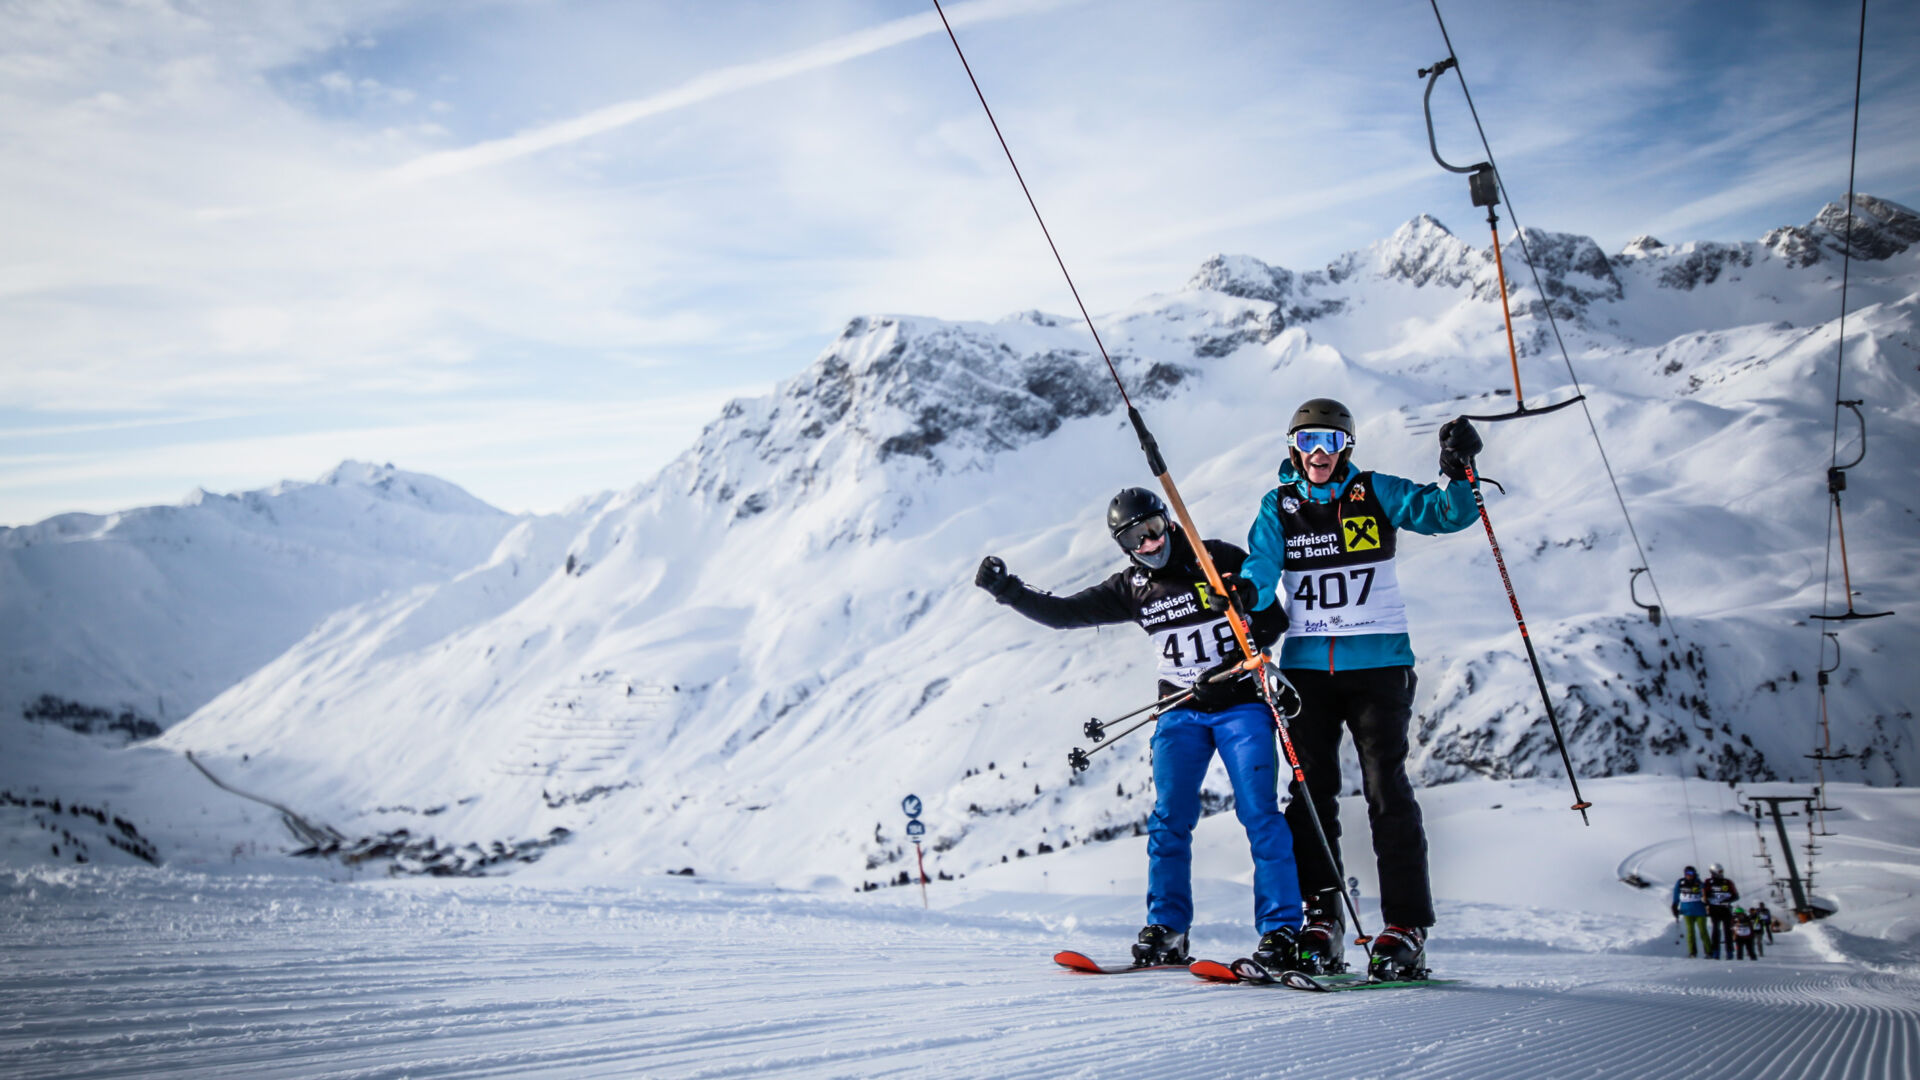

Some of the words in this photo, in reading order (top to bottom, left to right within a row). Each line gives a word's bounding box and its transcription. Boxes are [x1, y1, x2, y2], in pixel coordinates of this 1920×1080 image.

[1286, 533, 1337, 547] aiffeisen
[1305, 543, 1340, 558] Bank
[1293, 567, 1376, 611] 407
[1167, 602, 1199, 620] Bank
[1162, 622, 1235, 668] 418
